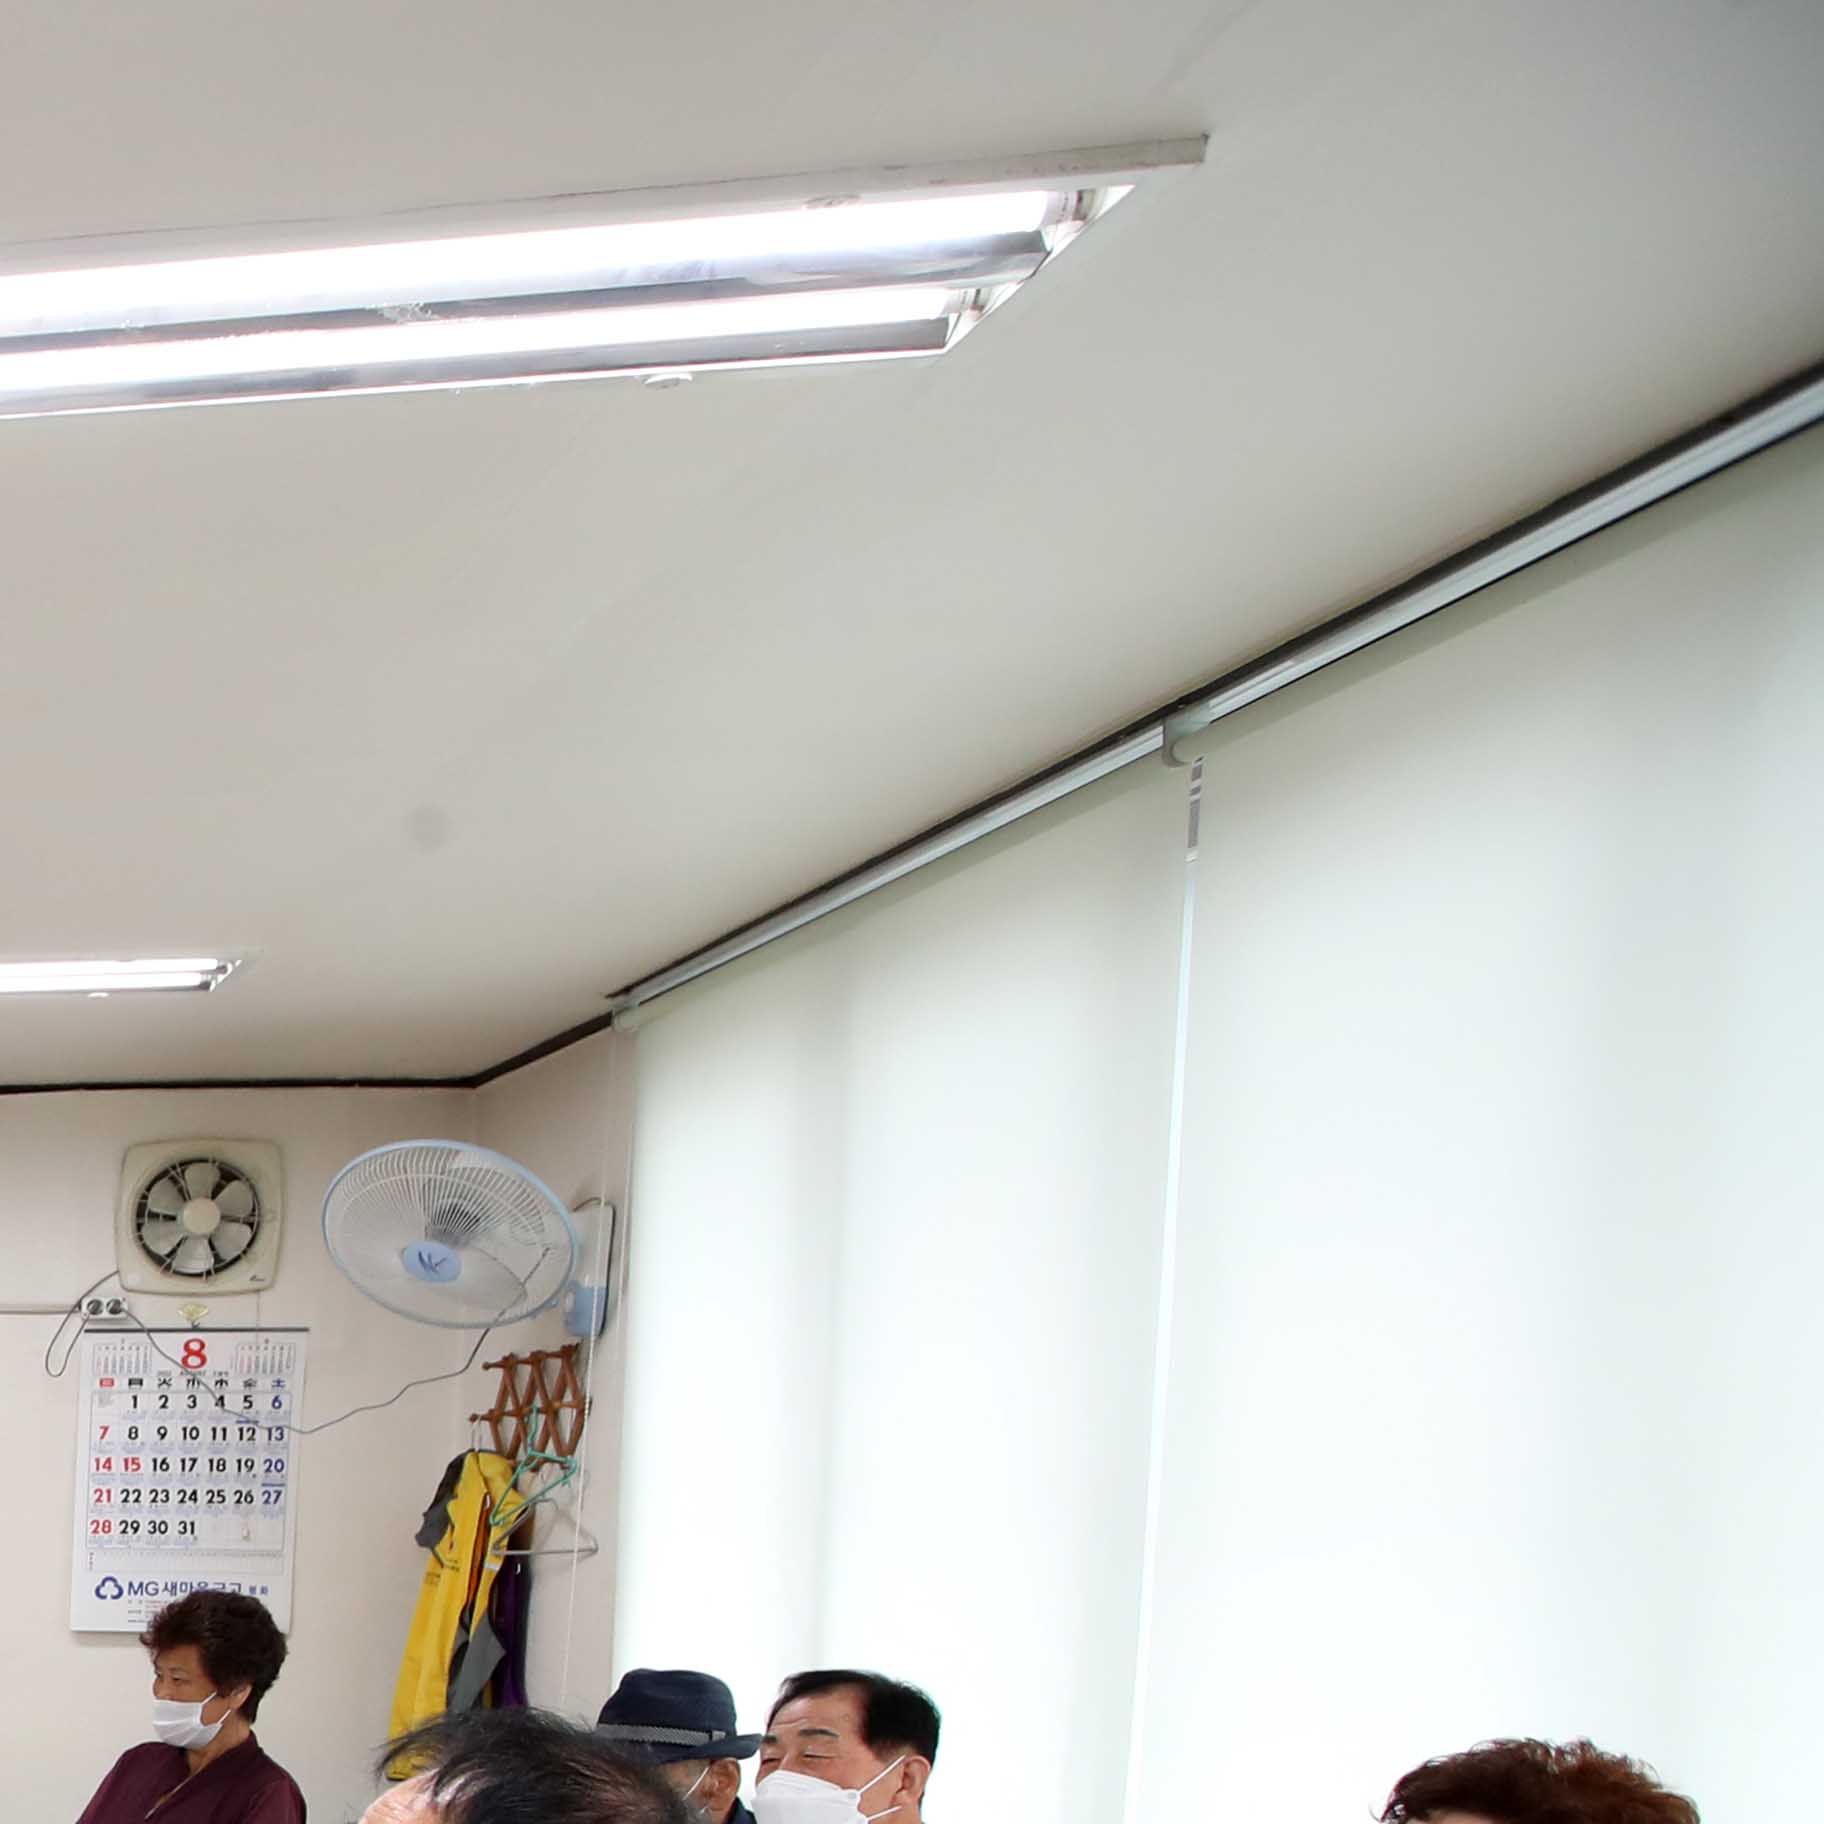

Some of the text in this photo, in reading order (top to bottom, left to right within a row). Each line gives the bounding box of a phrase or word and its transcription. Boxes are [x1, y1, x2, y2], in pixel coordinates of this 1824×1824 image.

[180, 1338, 208, 1370] 8
[271, 1378, 286, 1388] 土
[130, 1394, 282, 1410] 1 2 3 4 5 6
[98, 1426, 284, 1442] 7 8 9 10 11 12 13
[94, 1458, 284, 1474] 14 15 16 17 18 19 20
[94, 1488, 282, 1506] 21 22 23 24 25 26 27
[90, 1520, 196, 1534] 28 29 30 31
[128, 1581, 159, 1596] MG
